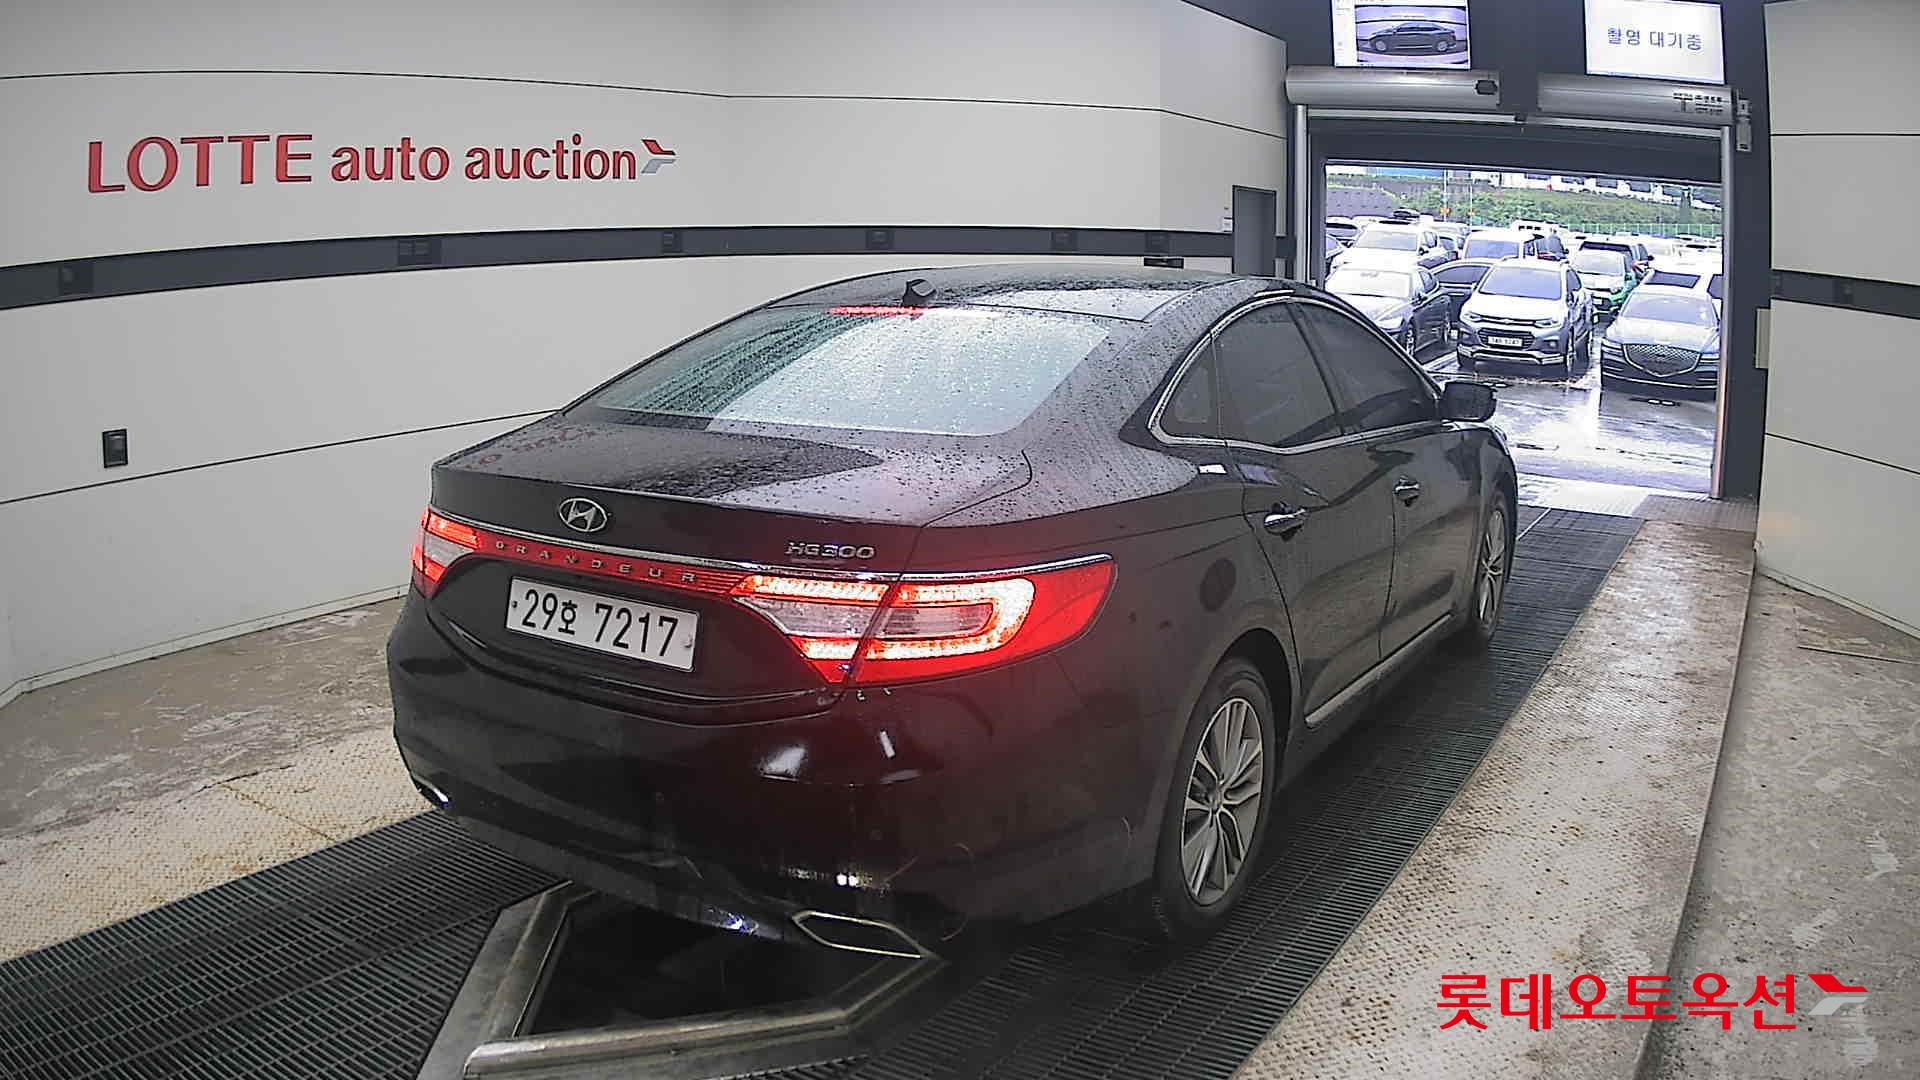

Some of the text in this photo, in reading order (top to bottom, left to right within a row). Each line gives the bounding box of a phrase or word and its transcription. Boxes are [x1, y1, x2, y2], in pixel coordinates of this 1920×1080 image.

[1607, 27, 1702, 51] 촬영 대기중
[88, 134, 637, 193] LOTTE auto auction
[495, 540, 696, 583] GRANDEUR
[784, 541, 876, 559] HG300
[522, 589, 679, 657] 29호 7217
